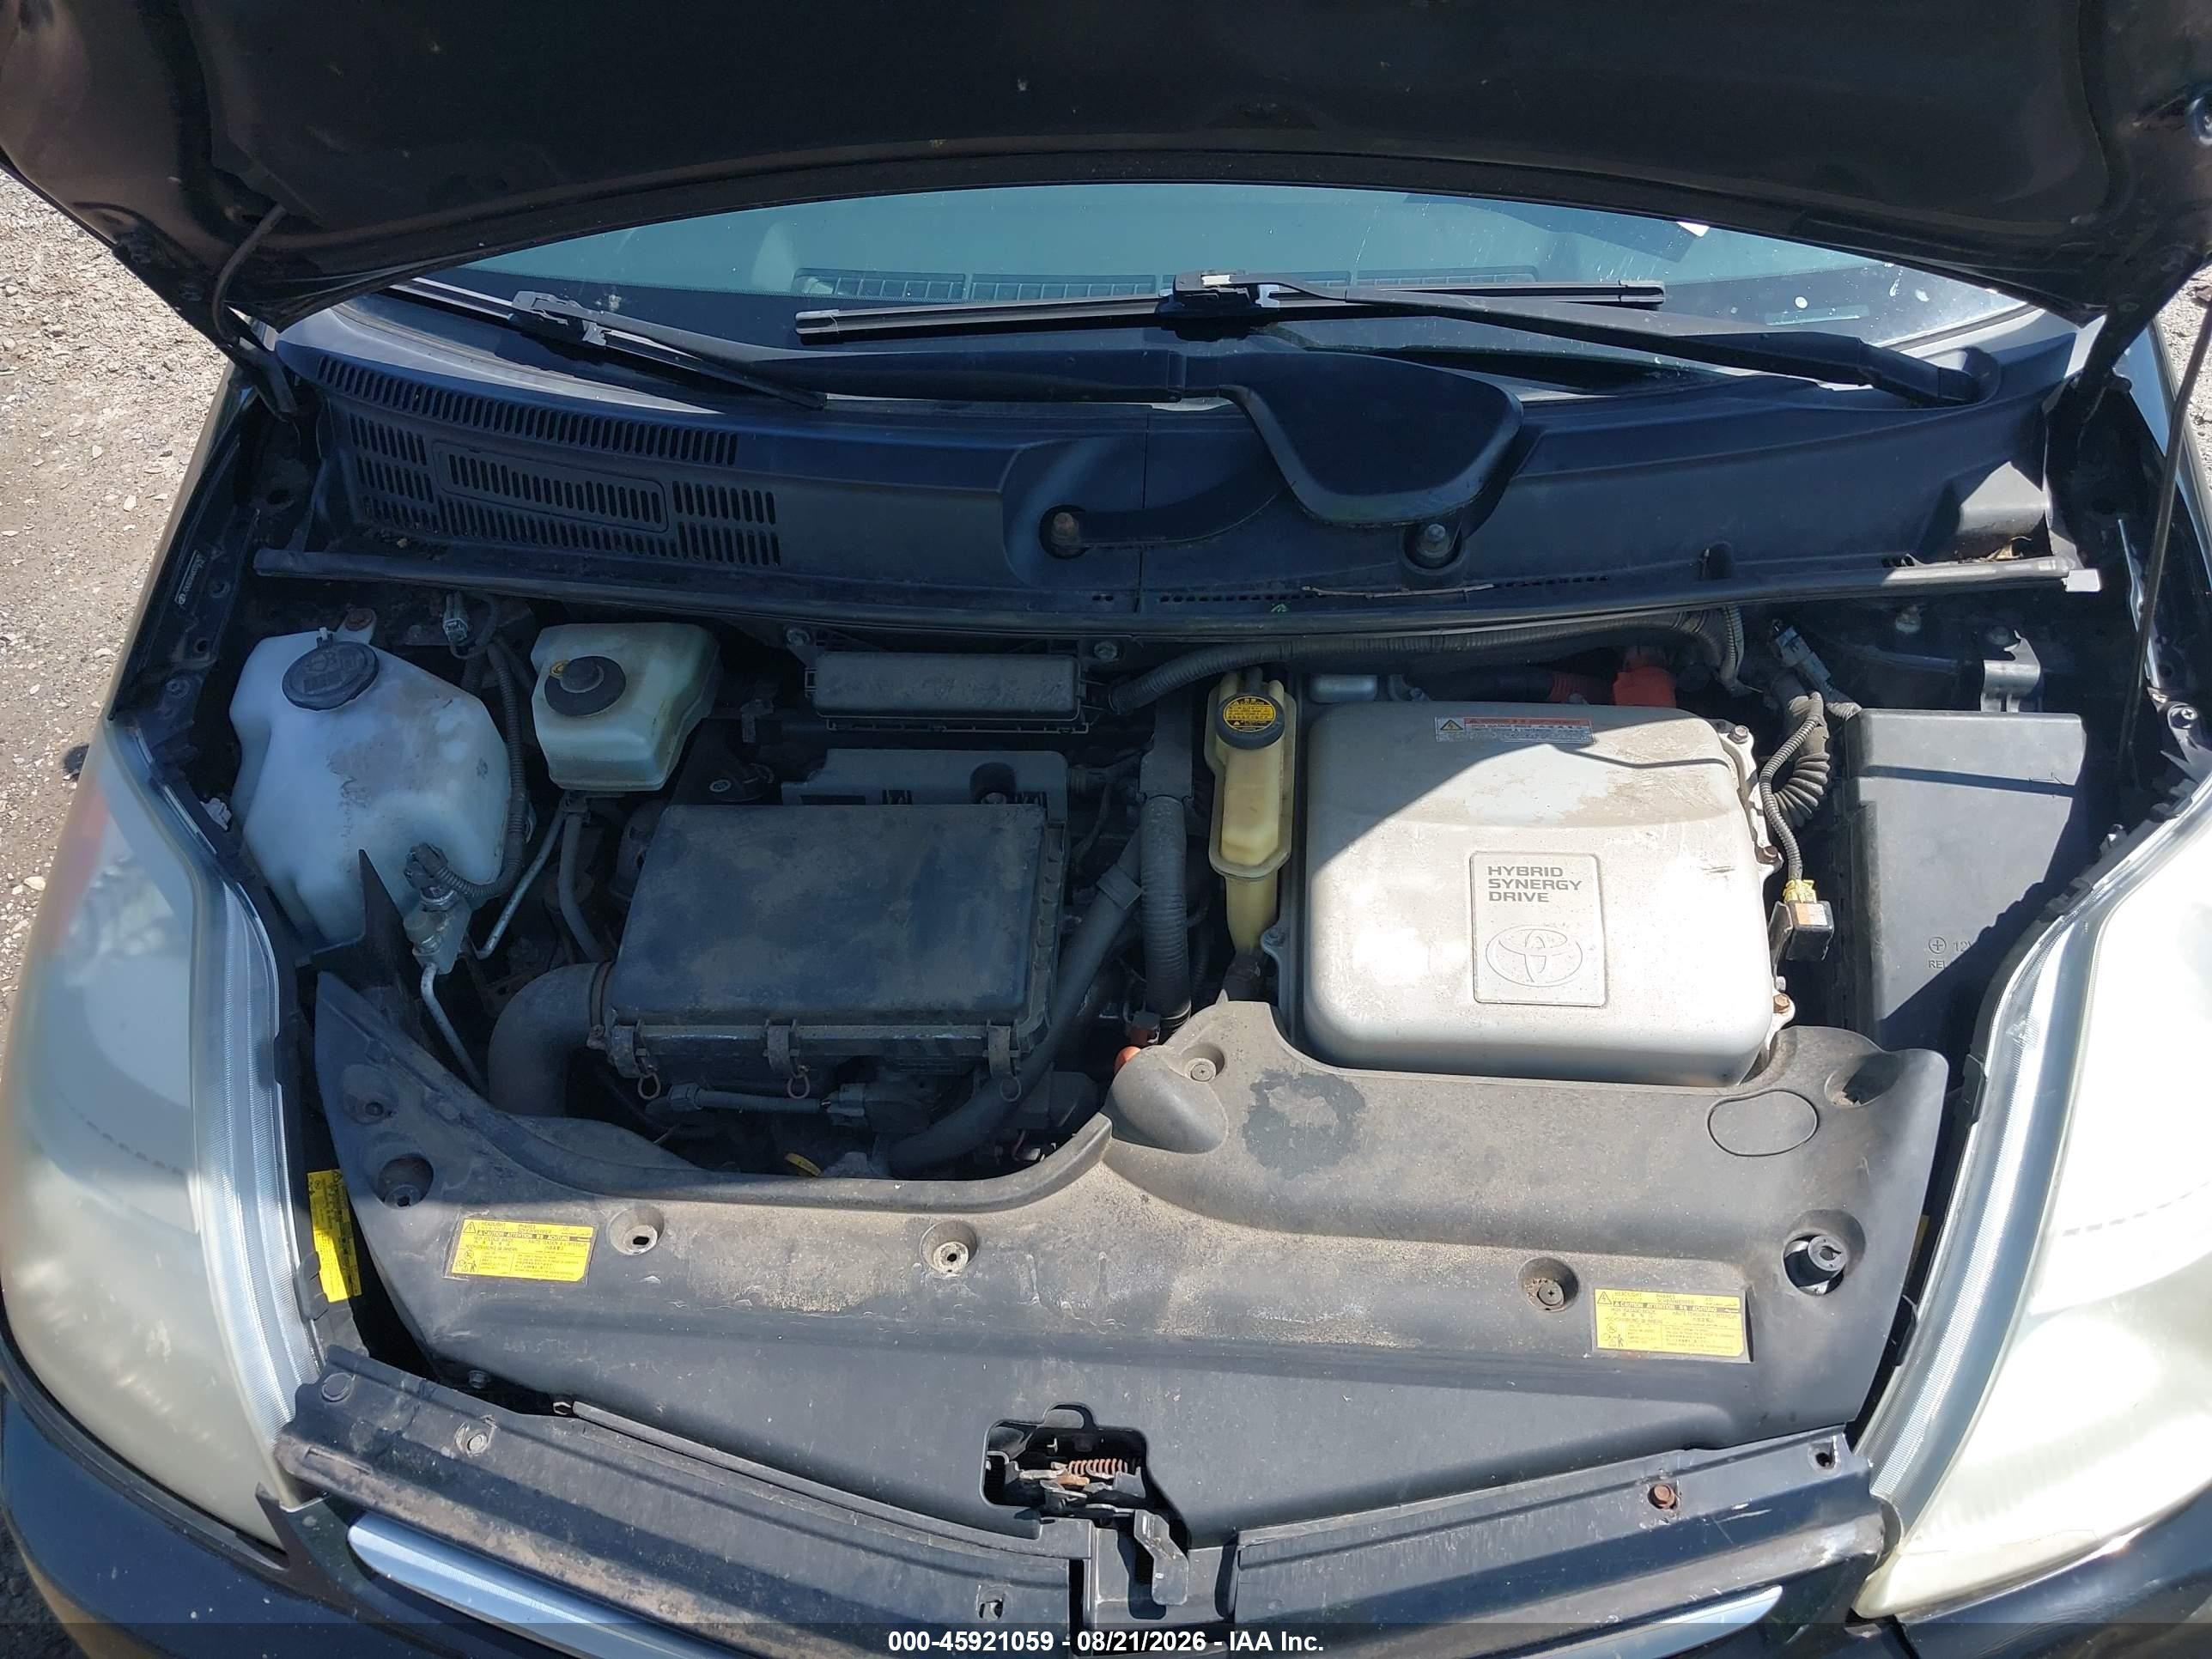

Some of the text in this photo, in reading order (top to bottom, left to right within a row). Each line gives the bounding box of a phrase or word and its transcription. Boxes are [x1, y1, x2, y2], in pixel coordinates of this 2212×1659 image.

[1488, 866, 1563, 877] HYBRID
[1488, 878, 1582, 890] SYNERGY
[1489, 891, 1549, 902] DRIVE
